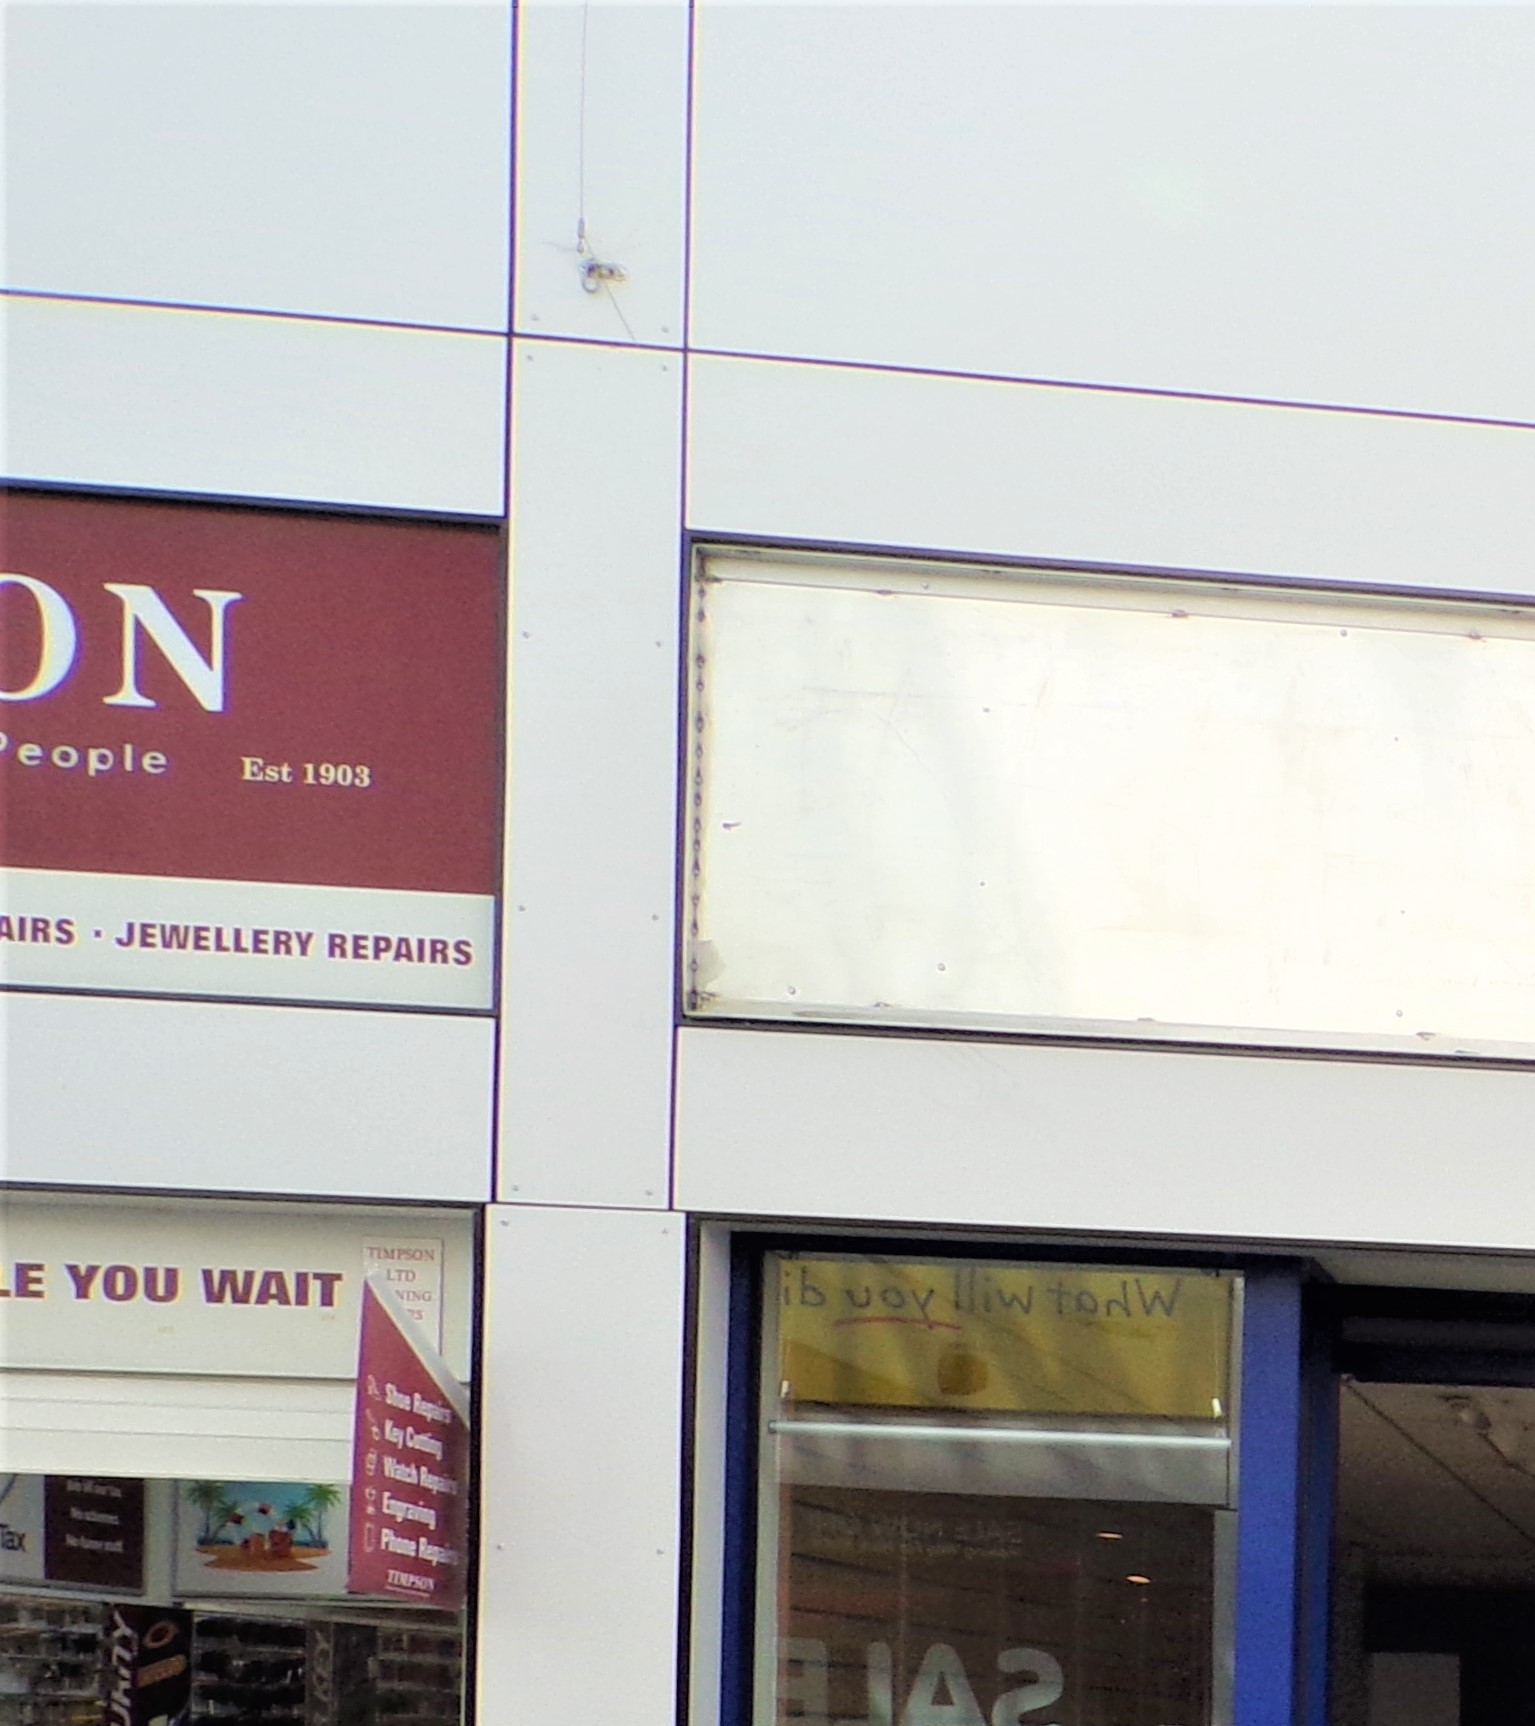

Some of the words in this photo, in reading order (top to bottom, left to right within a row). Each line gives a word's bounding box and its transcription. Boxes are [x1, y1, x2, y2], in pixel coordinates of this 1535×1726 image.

[241, 756, 292, 784] Est
[303, 761, 371, 788] 1903
[115, 922, 313, 957] JEWELLERY
[327, 934, 474, 966] REPAIRS
[367, 1246, 434, 1261] TIMPSON
[65, 1265, 179, 1302] YOU
[202, 1269, 343, 1307] WAIT
[386, 1267, 417, 1282] LTD
[383, 1456, 418, 1485] Watch
[388, 1569, 434, 1592] TIMPSON
